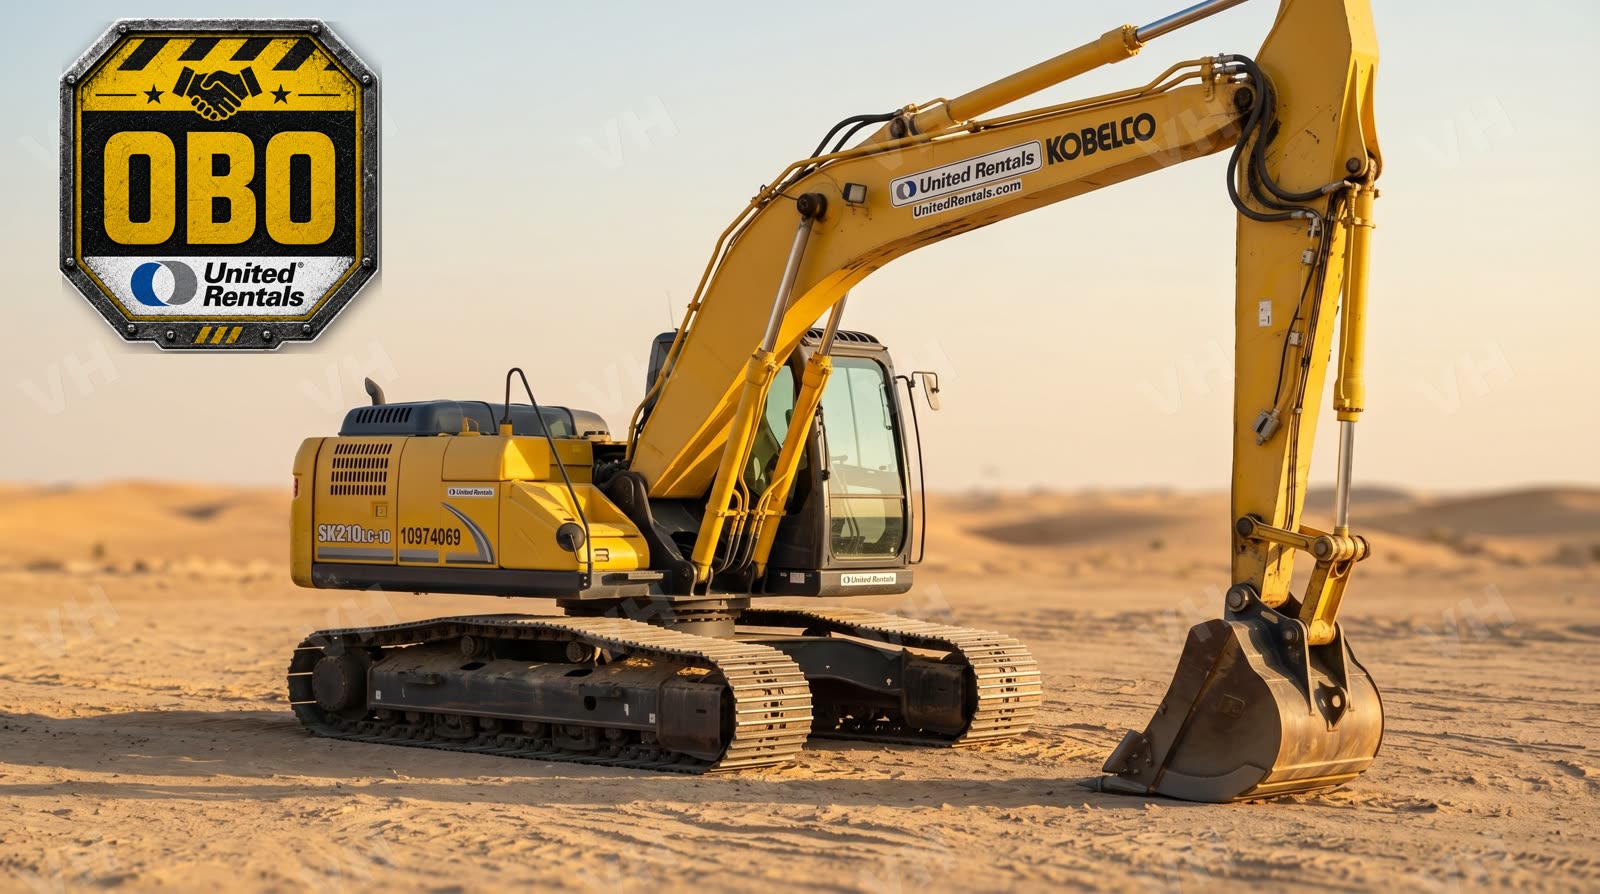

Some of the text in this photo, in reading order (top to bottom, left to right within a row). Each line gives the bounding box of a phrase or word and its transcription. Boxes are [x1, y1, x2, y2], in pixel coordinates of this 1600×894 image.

[1047, 113, 1156, 165] KOBELCO
[920, 148, 1035, 194] United Rentals
[913, 180, 1021, 218] UnitedRentals.com
[473, 488, 493, 496] Rentals
[400, 527, 461, 546] 10974069
[851, 575, 894, 583] United Rentals
